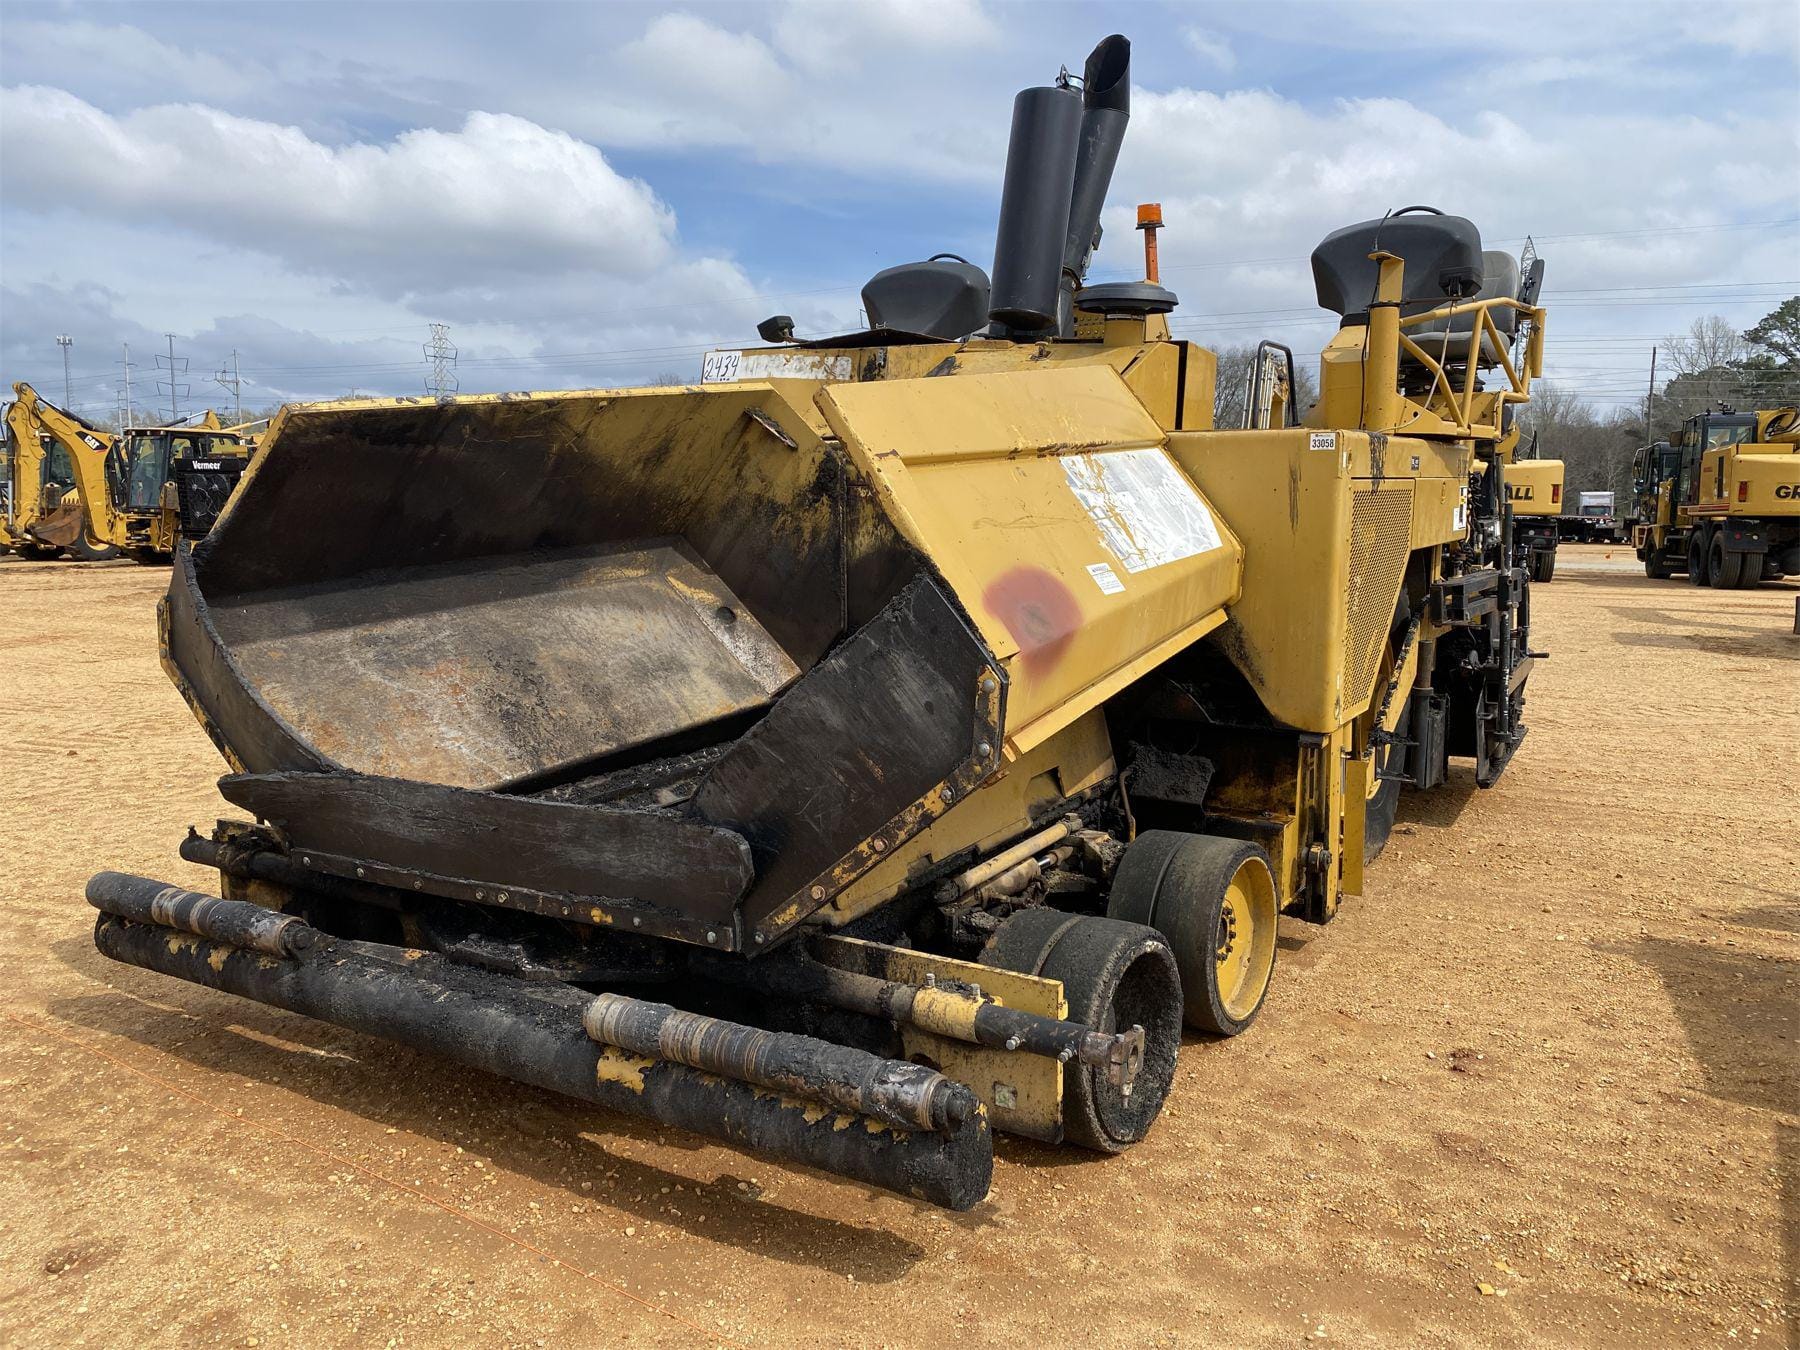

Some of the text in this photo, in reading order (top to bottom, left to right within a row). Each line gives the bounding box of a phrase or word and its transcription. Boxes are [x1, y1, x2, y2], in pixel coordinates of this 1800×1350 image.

[704, 355, 740, 379] 2434
[84, 434, 100, 449] CAT
[1312, 438, 1334, 448] 33058
[192, 460, 221, 470] Vermeer
